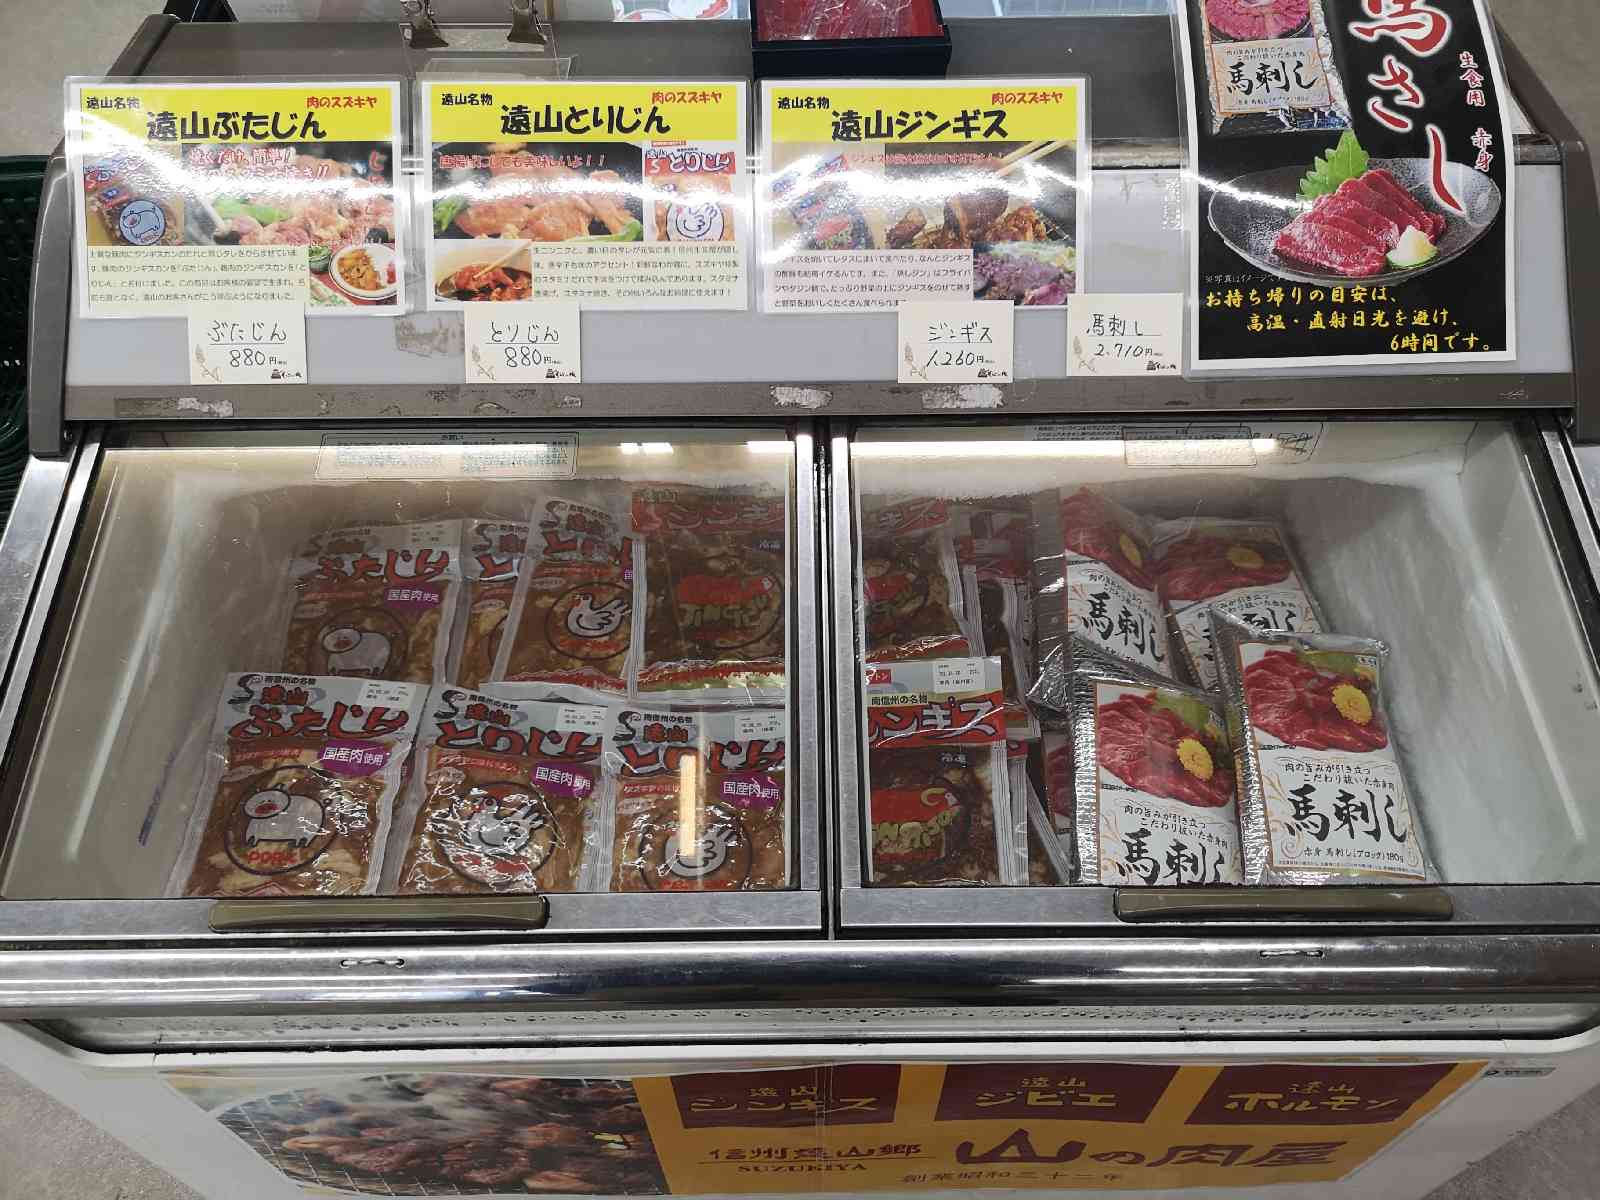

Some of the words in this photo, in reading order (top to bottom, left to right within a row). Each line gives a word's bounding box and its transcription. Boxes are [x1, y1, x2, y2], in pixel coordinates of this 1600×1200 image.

[1227, 62, 1319, 95] 馬刺し
[1459, 51, 1488, 107] 生食用
[86, 96, 140, 109] 遠山名物
[306, 96, 378, 109] 肉のスズキヤ
[441, 93, 493, 106] 遠山名物
[651, 92, 722, 104] 肉のスズキヤ
[778, 97, 830, 110] 遠山名物
[991, 92, 1063, 105] 肉のスズキヤ
[147, 111, 327, 141] 遠山ぶたじん
[500, 105, 671, 134] 遠山とりじん
[831, 110, 1009, 141] 遠山ジンギス
[1471, 128, 1493, 173] 赤身
[1206, 286, 1399, 307] お持ち帰りの目安は、
[208, 320, 287, 341] ぶたじん
[1086, 313, 1144, 336] 馬刺し
[1246, 309, 1458, 331] 高温・直射日光を避け、
[491, 321, 559, 343] とりじん
[928, 321, 992, 343] ジンギス
[1391, 332, 1491, 352] 6時間です。
[1081, 591, 1165, 662] 馬刺し
[872, 694, 928, 706] 南信州の名物
[228, 701, 409, 739] ぶたじん
[435, 720, 604, 762] とりじん
[323, 747, 384, 765] 国産肉使用
[1285, 762, 1371, 775] 肉の旨みが引き立つ
[1124, 805, 1207, 829] 肉の旨みが引き立つ
[1285, 783, 1408, 843] 馬刺し
[1116, 828, 1226, 886] 馬刺し
[1021, 1077, 1086, 1088] 遠山
[976, 1089, 1117, 1107] ジビエ
[1223, 1092, 1399, 1111] ホルモン
[709, 1142, 921, 1161] 信州遠山郷
[955, 1128, 1348, 1168] 山の肉屋
[737, 1162, 868, 1173] SUZUKIYA
